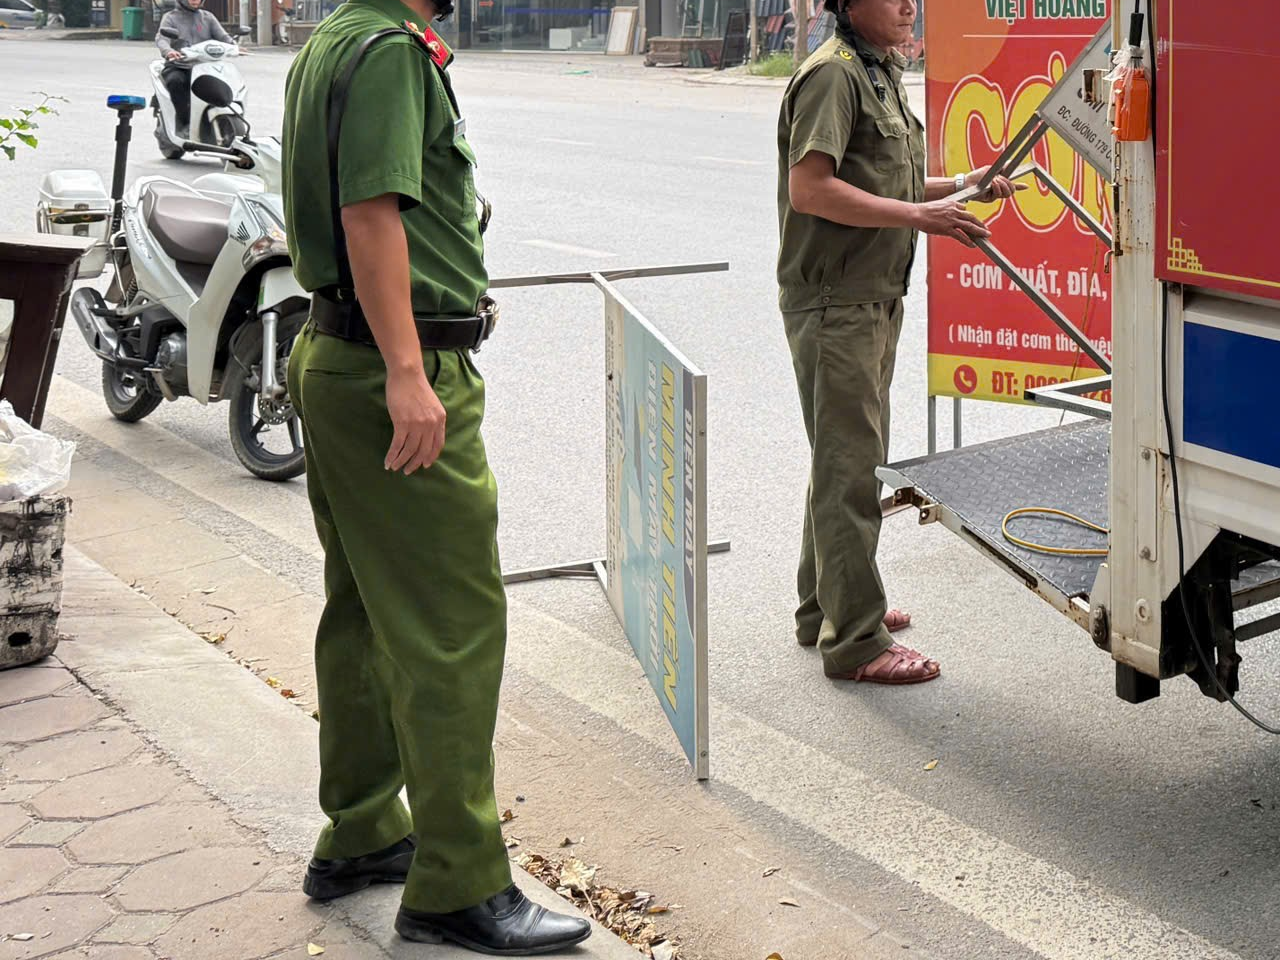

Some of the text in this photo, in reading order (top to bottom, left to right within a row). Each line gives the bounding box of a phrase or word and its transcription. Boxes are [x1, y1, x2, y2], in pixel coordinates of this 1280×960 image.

[940, 50, 1112, 237] CƠ
[960, 263, 1003, 290] CƠM
[958, 324, 993, 348] Nhận
[1021, 333, 1051, 351] cơm
[1055, 334, 1086, 353] the
[992, 370, 1019, 396] ĐT:
[662, 361, 675, 548] MINH
